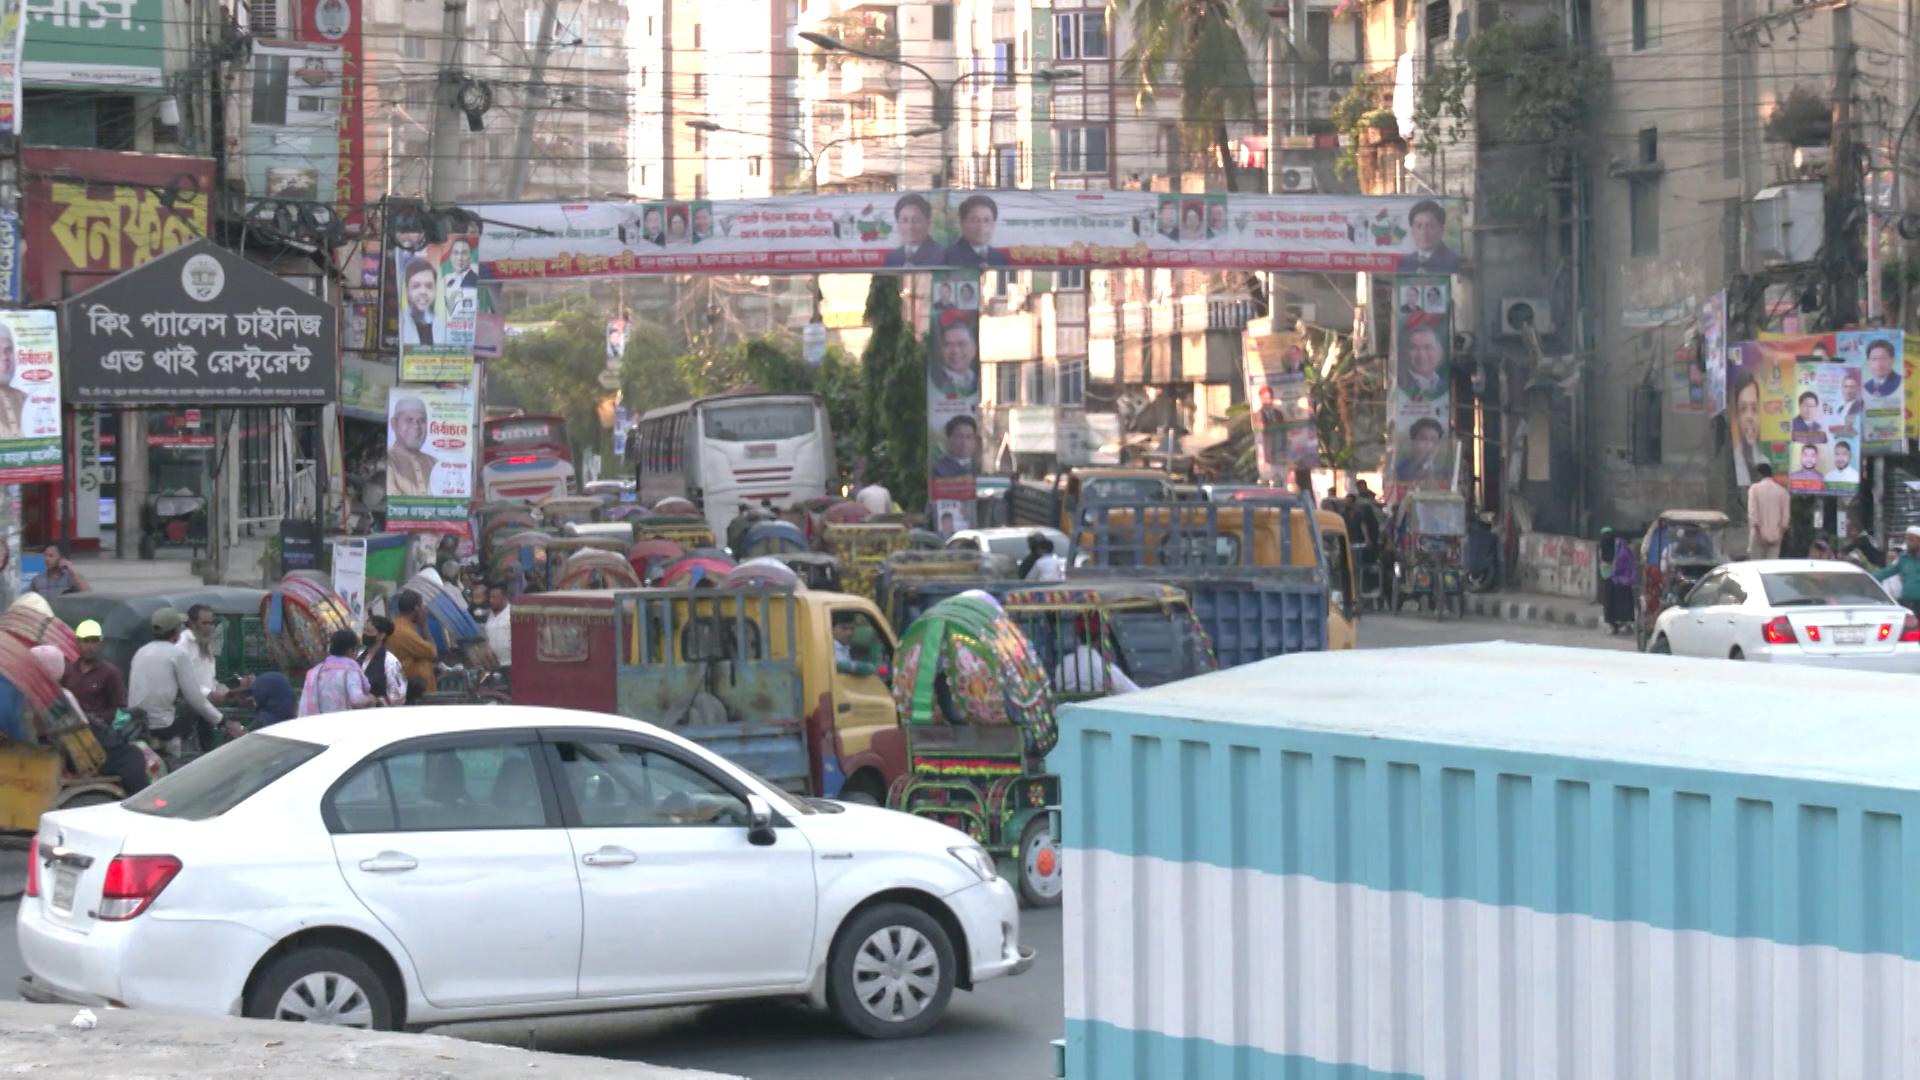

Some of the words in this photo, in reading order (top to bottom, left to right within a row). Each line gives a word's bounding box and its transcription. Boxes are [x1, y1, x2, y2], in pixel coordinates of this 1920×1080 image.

[86, 304, 134, 338] কিং
[140, 309, 228, 337] প্যালেস
[233, 305, 323, 341] চাইনিজ
[100, 349, 147, 374] এন্ড
[152, 342, 199, 377] থাই
[207, 342, 313, 382] রেস্টুরেন্ট
